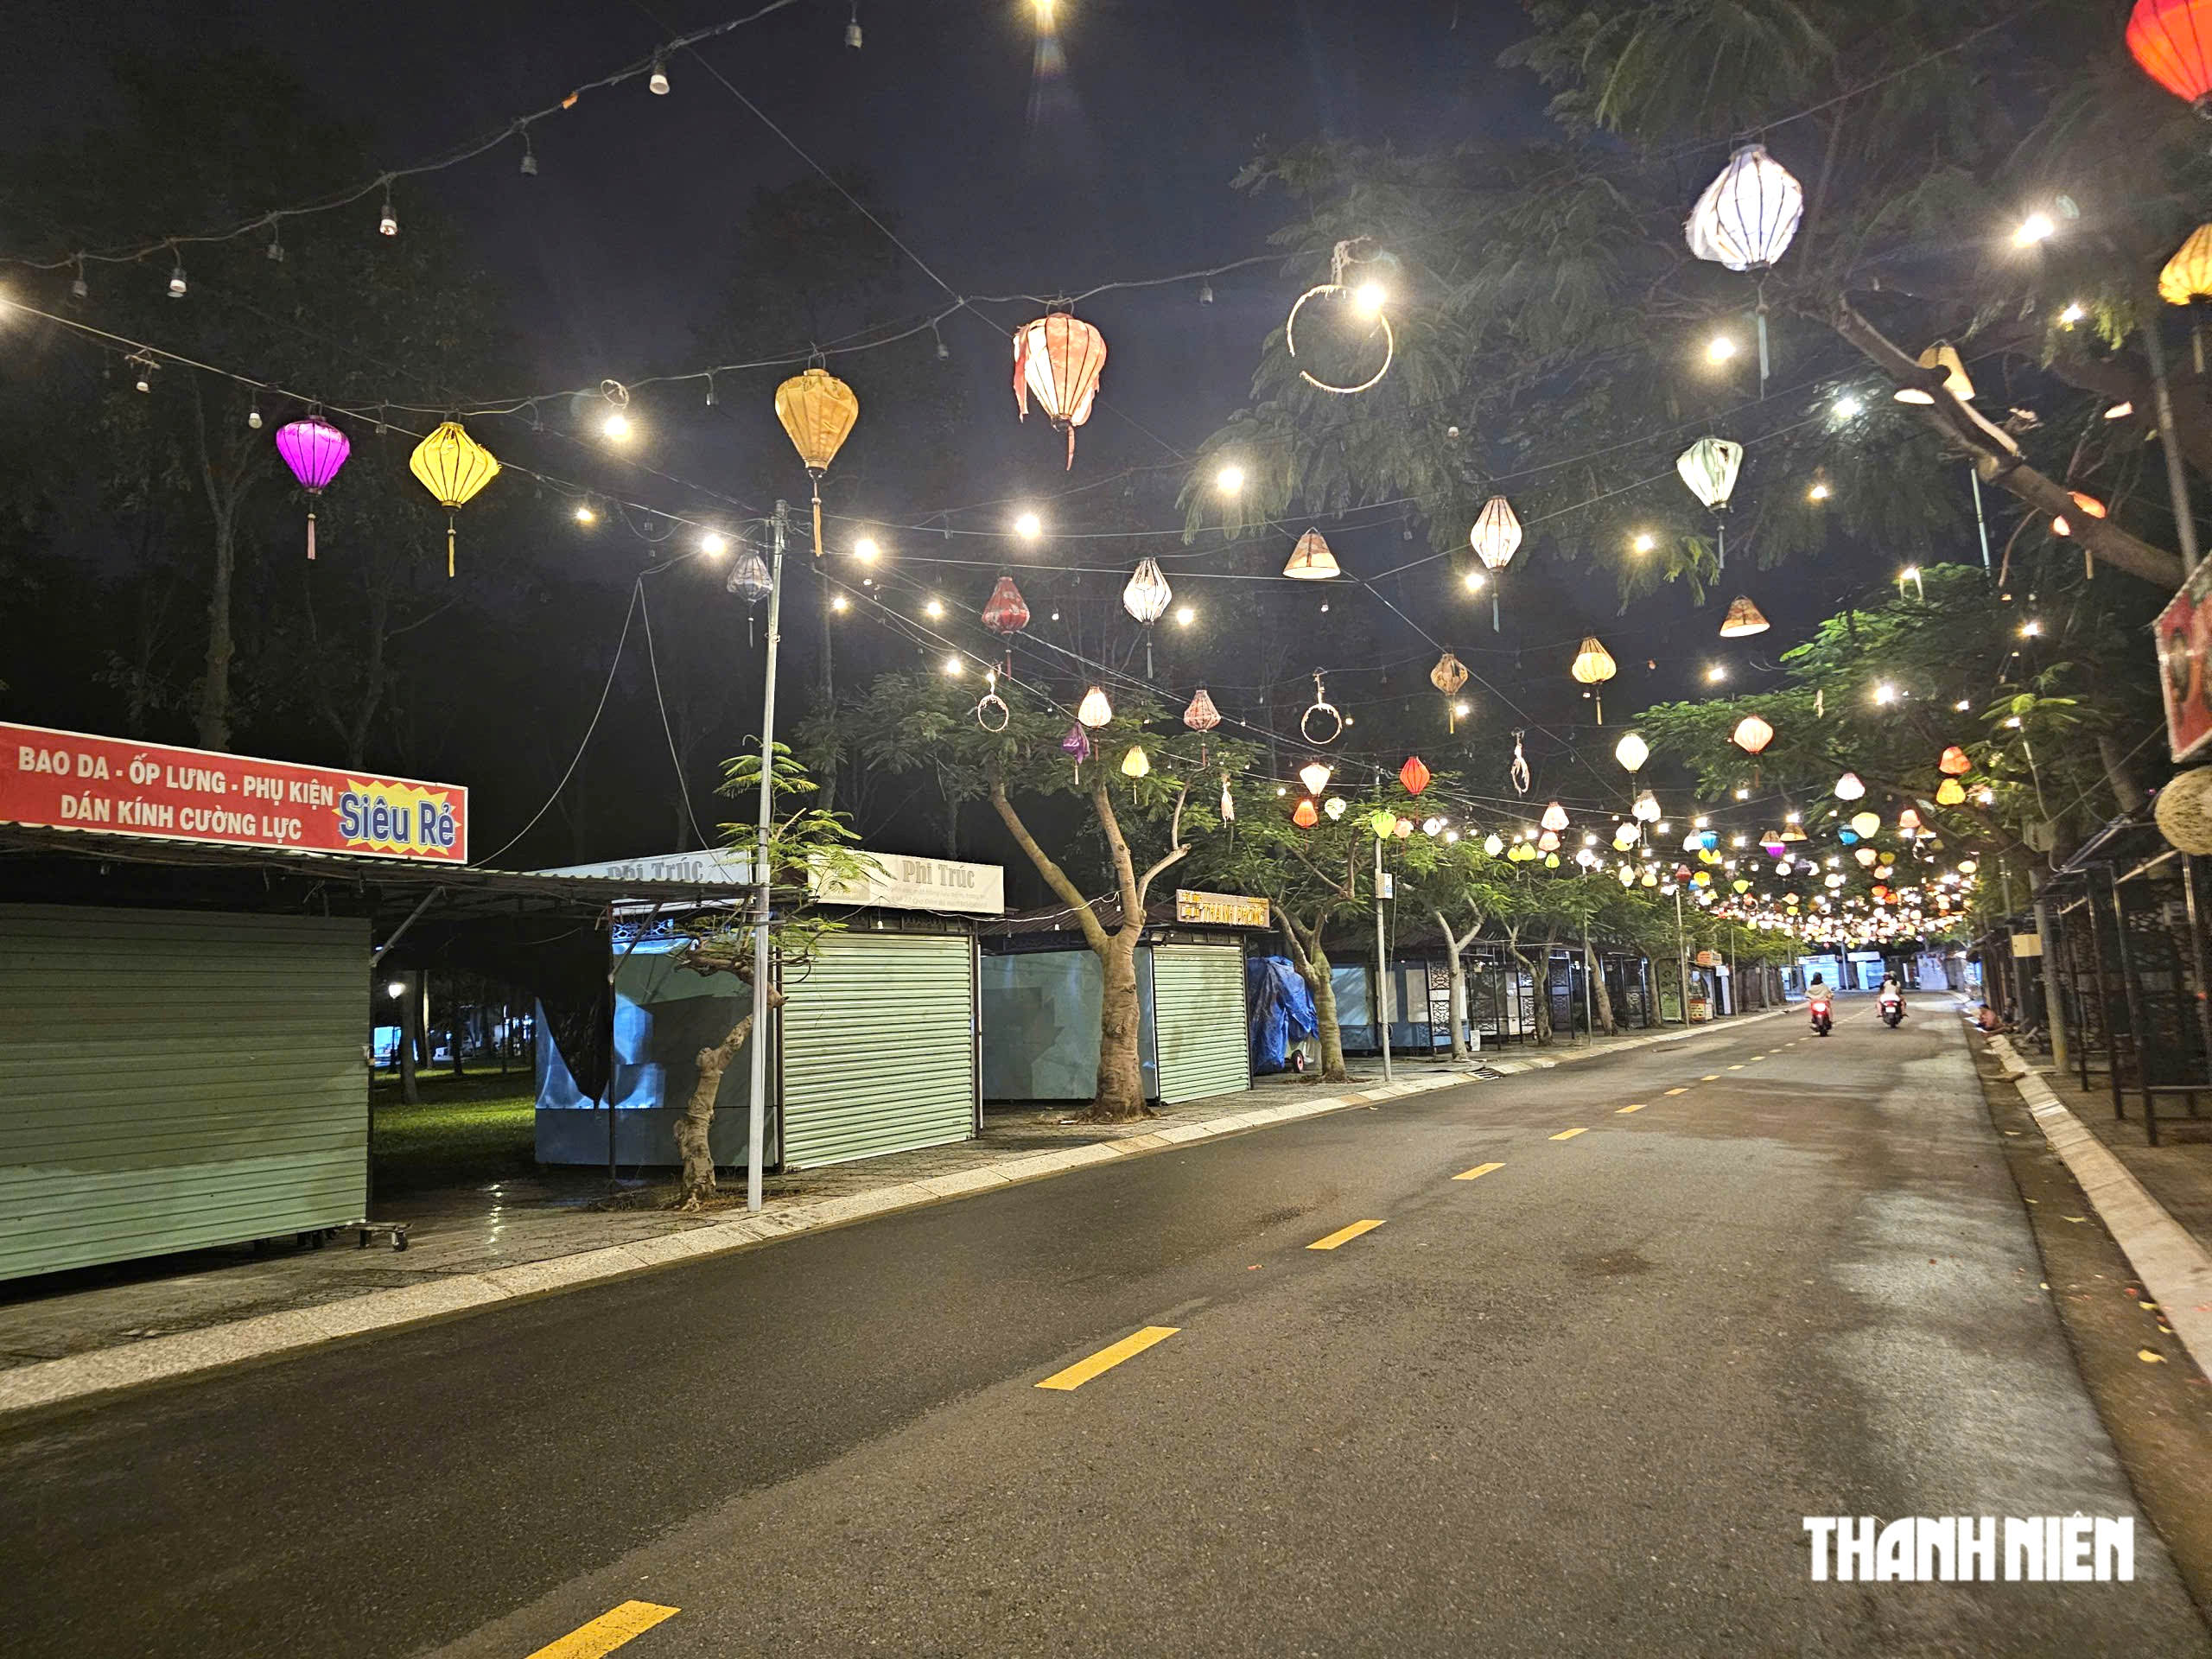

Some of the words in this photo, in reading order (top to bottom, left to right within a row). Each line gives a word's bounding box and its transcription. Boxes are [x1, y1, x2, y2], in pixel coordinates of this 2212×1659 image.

[19, 747, 70, 775] BAO
[77, 753, 110, 780] DA
[130, 753, 161, 785] ỐP
[166, 766, 226, 794] LƯNG
[243, 775, 283, 806] PHỤ
[289, 779, 334, 810] KIỆN
[60, 791, 111, 822] DÁN
[118, 796, 173, 828] KÍNH
[180, 804, 256, 836] CƯỜNG
[262, 816, 302, 844] LỰC
[339, 791, 410, 844] Siêu
[419, 801, 456, 848] Rẻ
[607, 864, 644, 879] Phi
[652, 857, 703, 881] Trúc
[902, 860, 932, 885] Phi
[938, 863, 976, 889] Trúc
